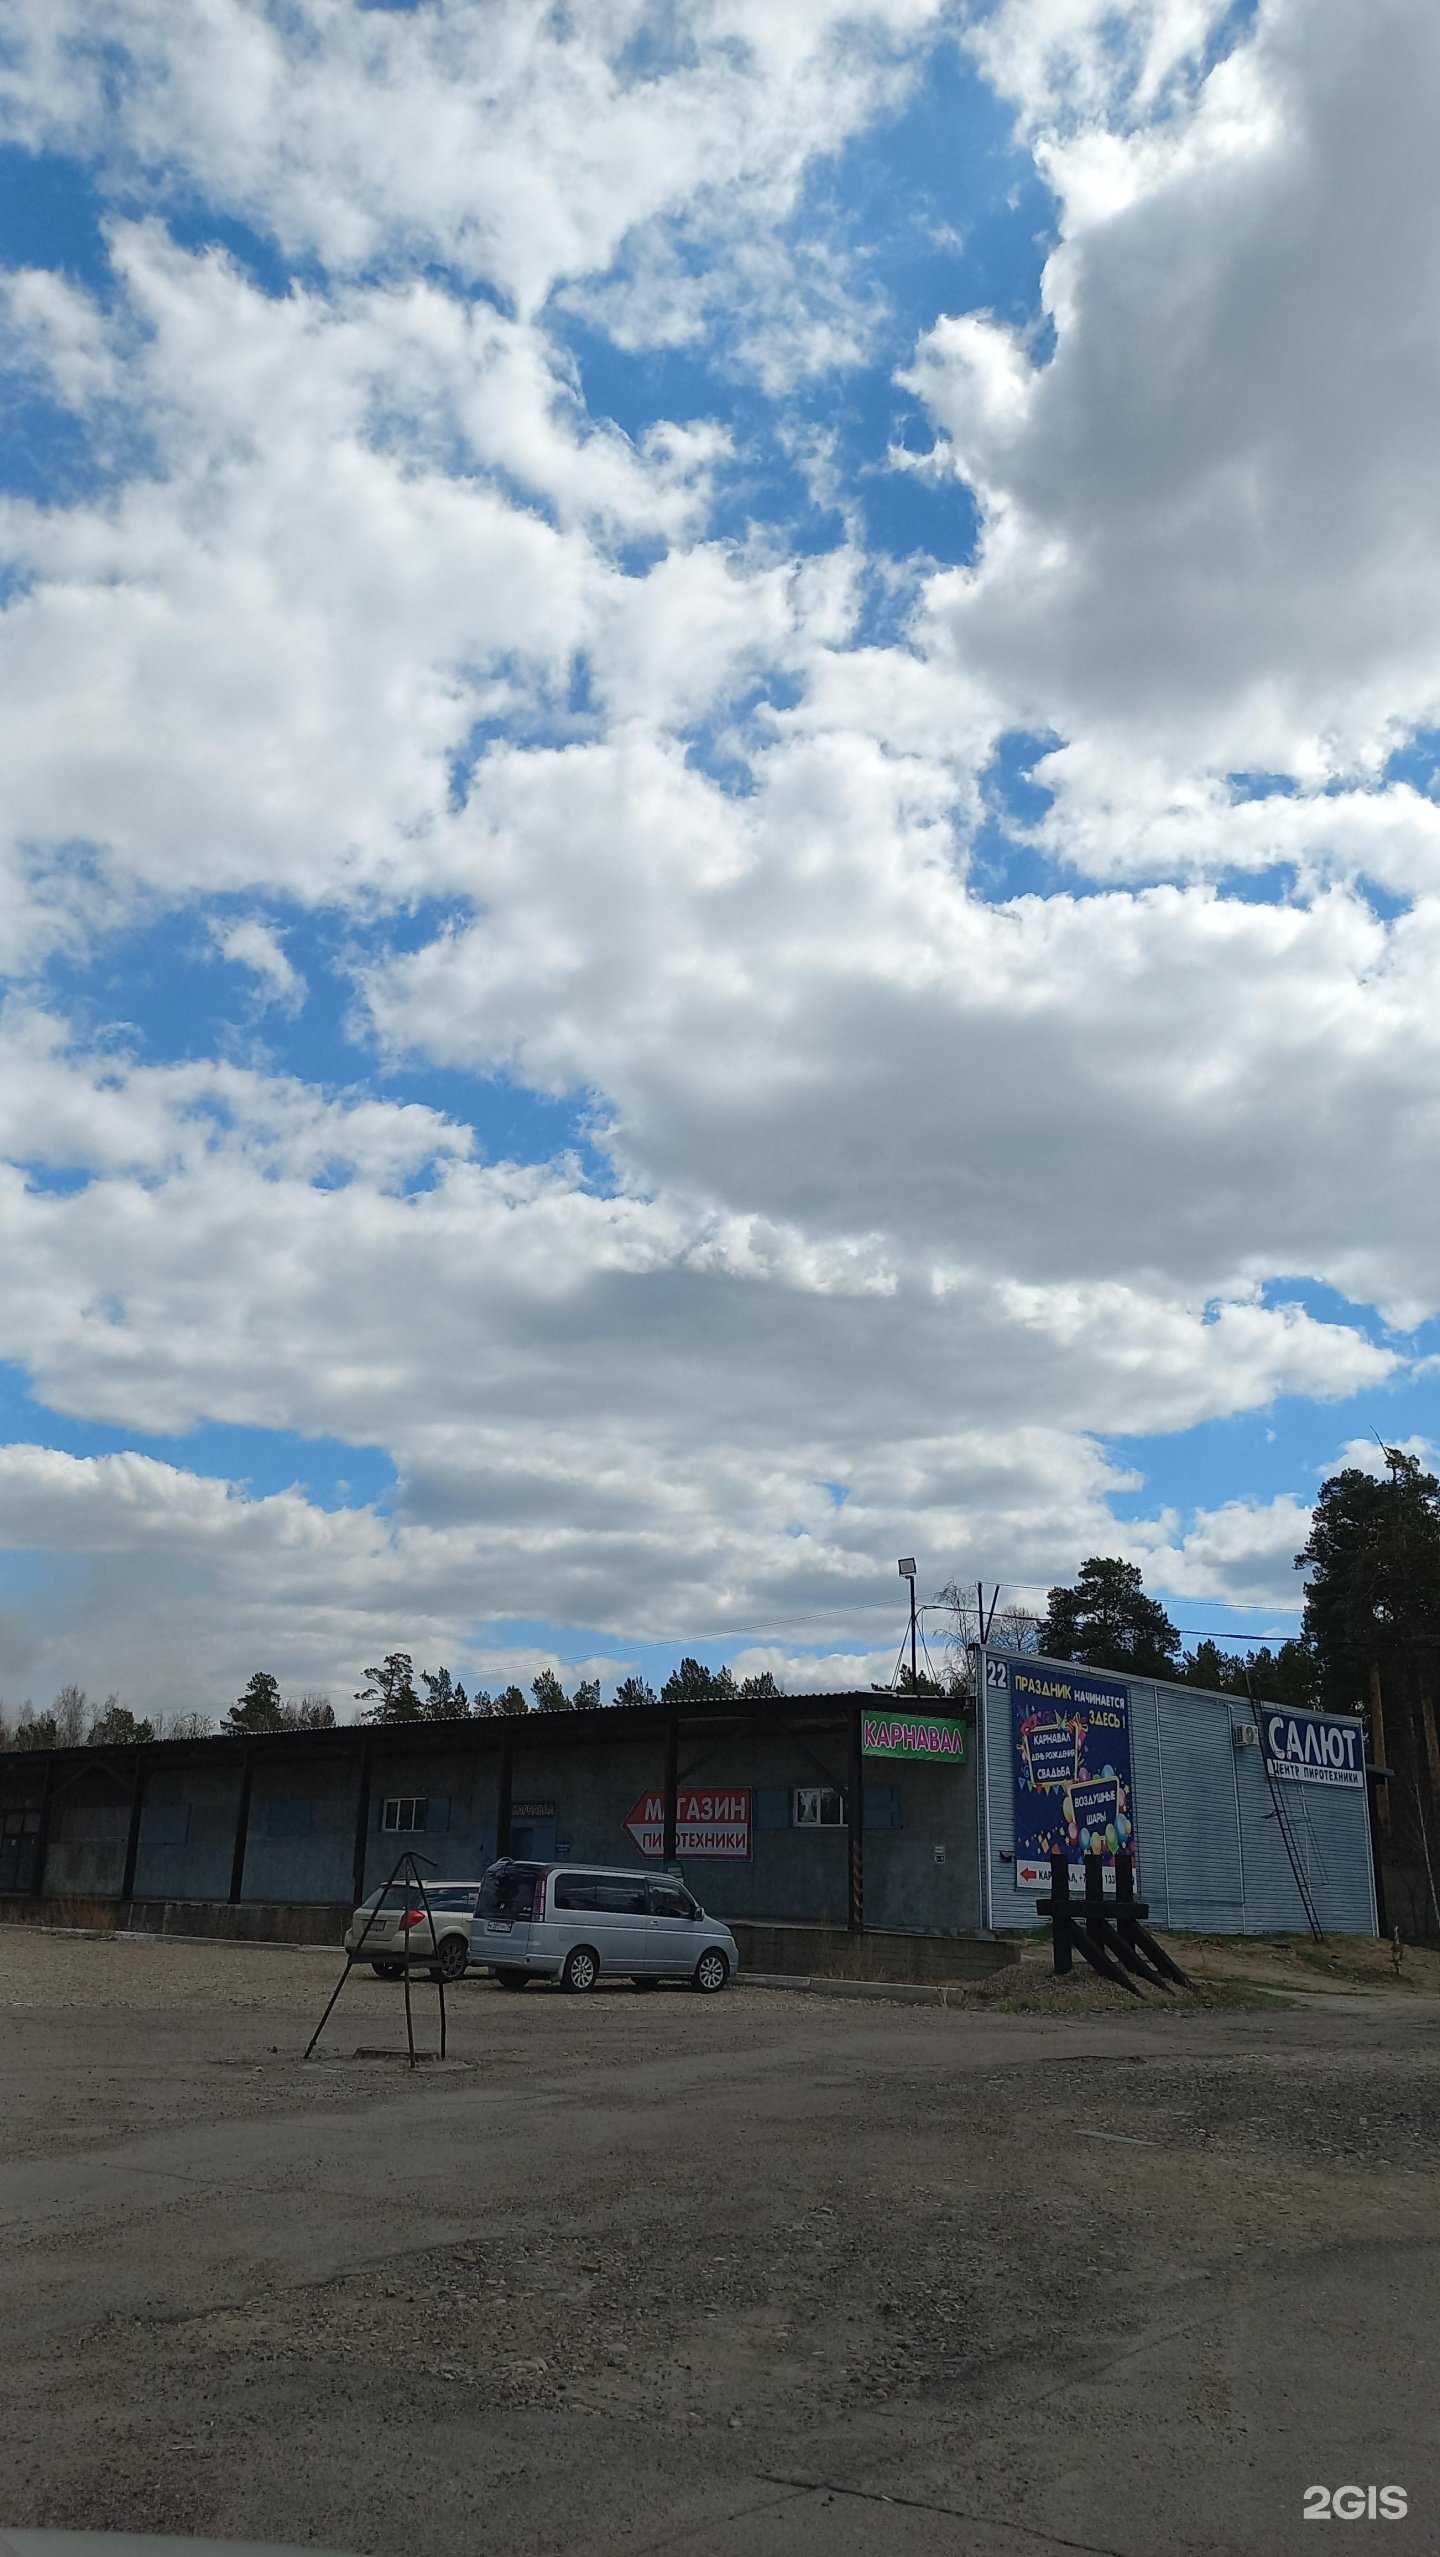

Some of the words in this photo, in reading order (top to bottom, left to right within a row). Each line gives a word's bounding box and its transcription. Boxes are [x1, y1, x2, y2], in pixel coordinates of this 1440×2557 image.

[987, 1660, 1008, 1688] 22
[1015, 1675, 1072, 1700] ПРАЗДНИК
[1074, 1690, 1125, 1709] НАЧИНАЕТСЯ
[1089, 1710, 1120, 1728] ЗДЕСЬ
[864, 1720, 963, 1754] КАРНАВАЛ
[1033, 1732, 1071, 1746] КАРНАВАЛ
[1268, 1716, 1356, 1769] САЛЮТ
[1037, 1766, 1071, 1780] СВАДЬБА
[1273, 1761, 1300, 1777] ЦЕНТР
[1303, 1767, 1359, 1785] ПИРОТЕХНИКИ
[645, 1797, 746, 1821] МГАЗИН
[1074, 1790, 1116, 1808] ВОЗДУШНЫЕ
[1086, 1811, 1107, 1825] ШАРЫ
[642, 1832, 746, 1849] ПИОТЕХНИКИ
